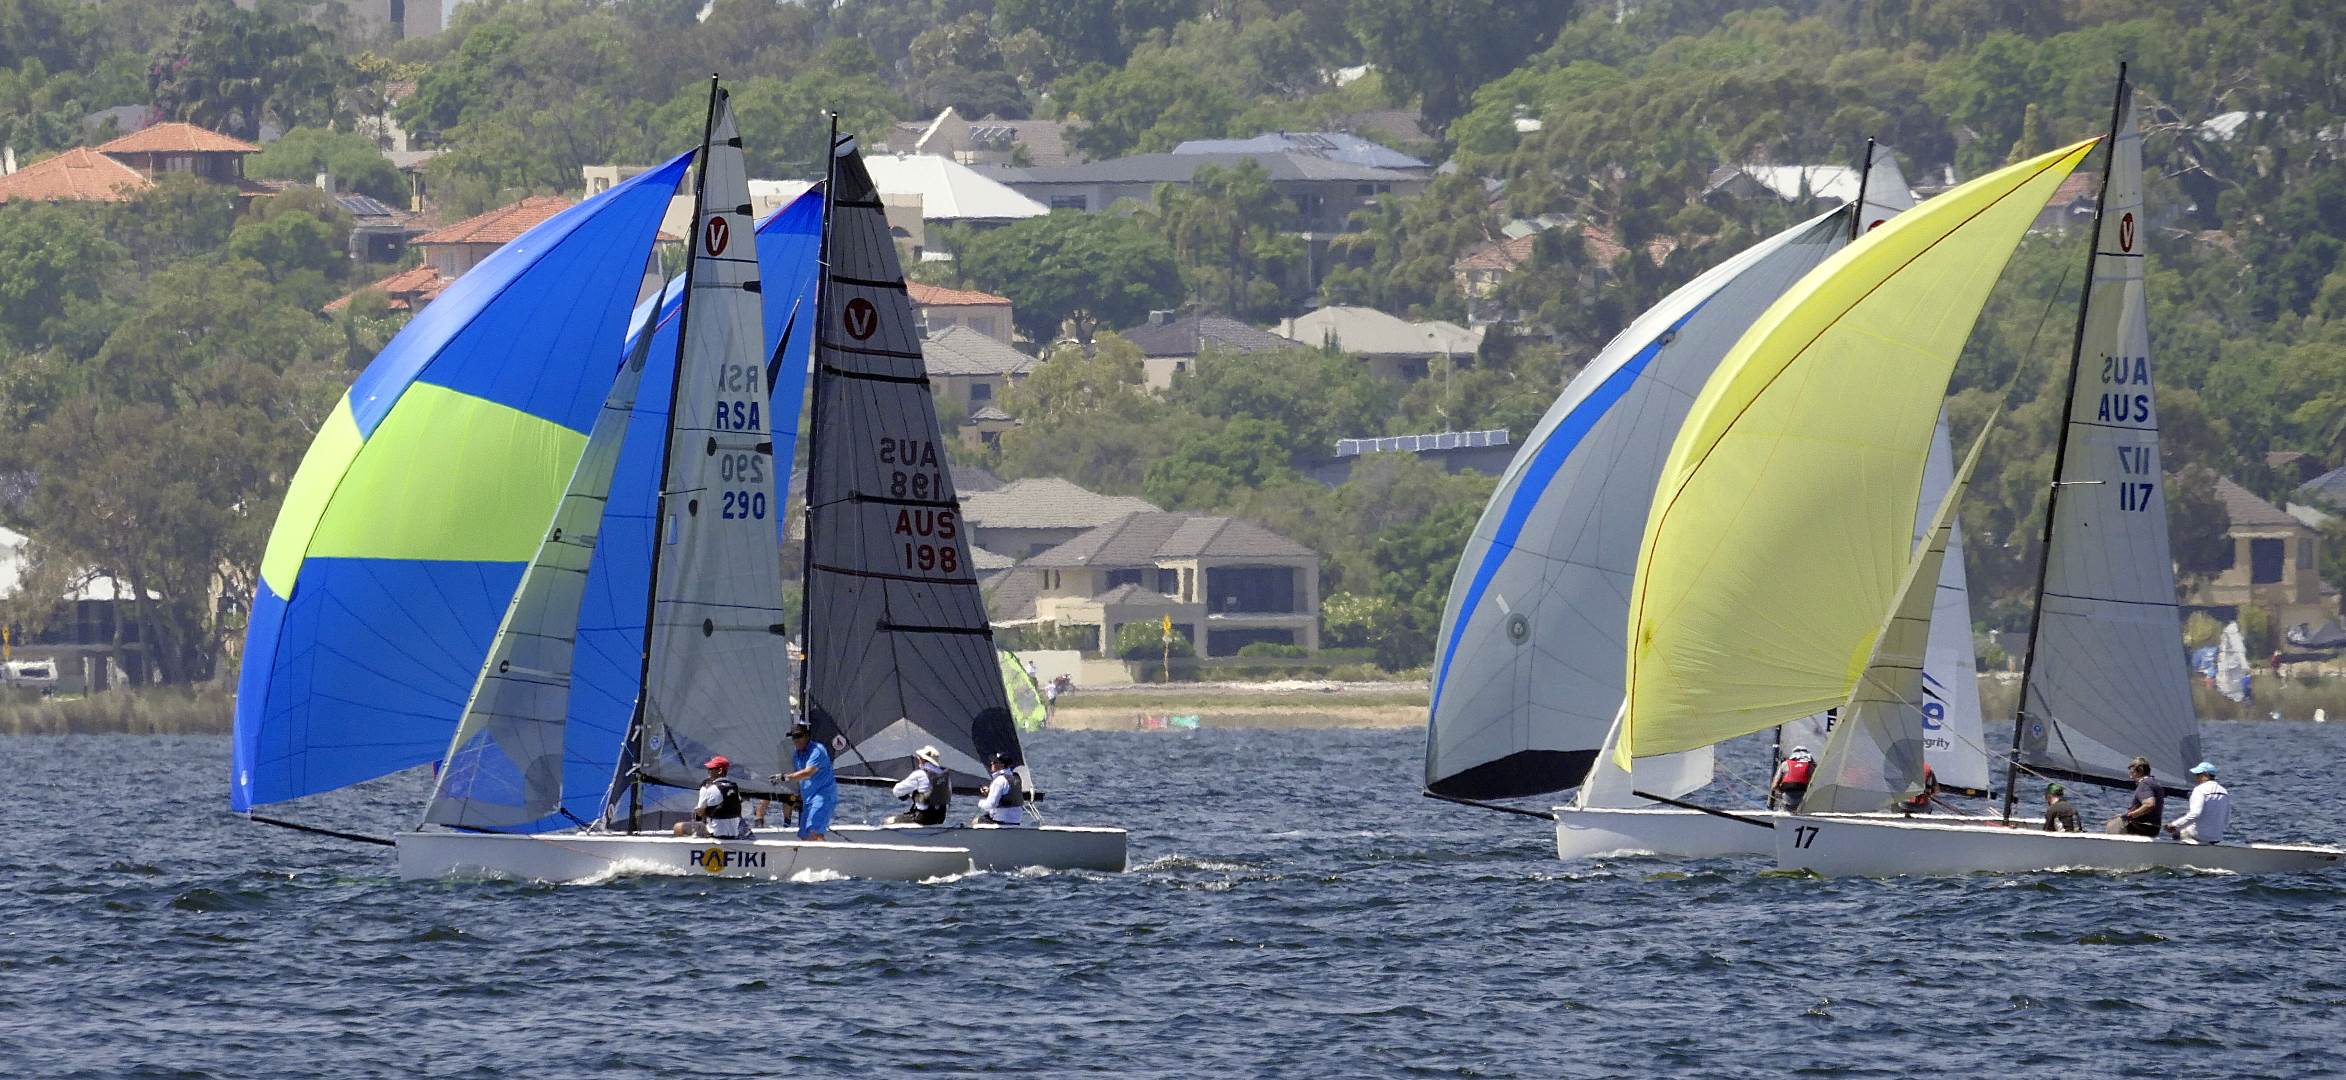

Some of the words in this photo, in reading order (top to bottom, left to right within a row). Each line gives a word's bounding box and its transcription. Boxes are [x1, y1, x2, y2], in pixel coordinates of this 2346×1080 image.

[709, 223, 726, 252] V
[849, 307, 872, 336] V
[716, 400, 761, 431] RSA
[2098, 393, 2149, 423] AUS
[722, 490, 766, 520] 290
[2120, 482, 2154, 513] 117
[895, 509, 956, 540] AUS
[906, 543, 957, 573] 198
[1794, 825, 1820, 849] 17
[690, 849, 767, 868] RAFIKI
